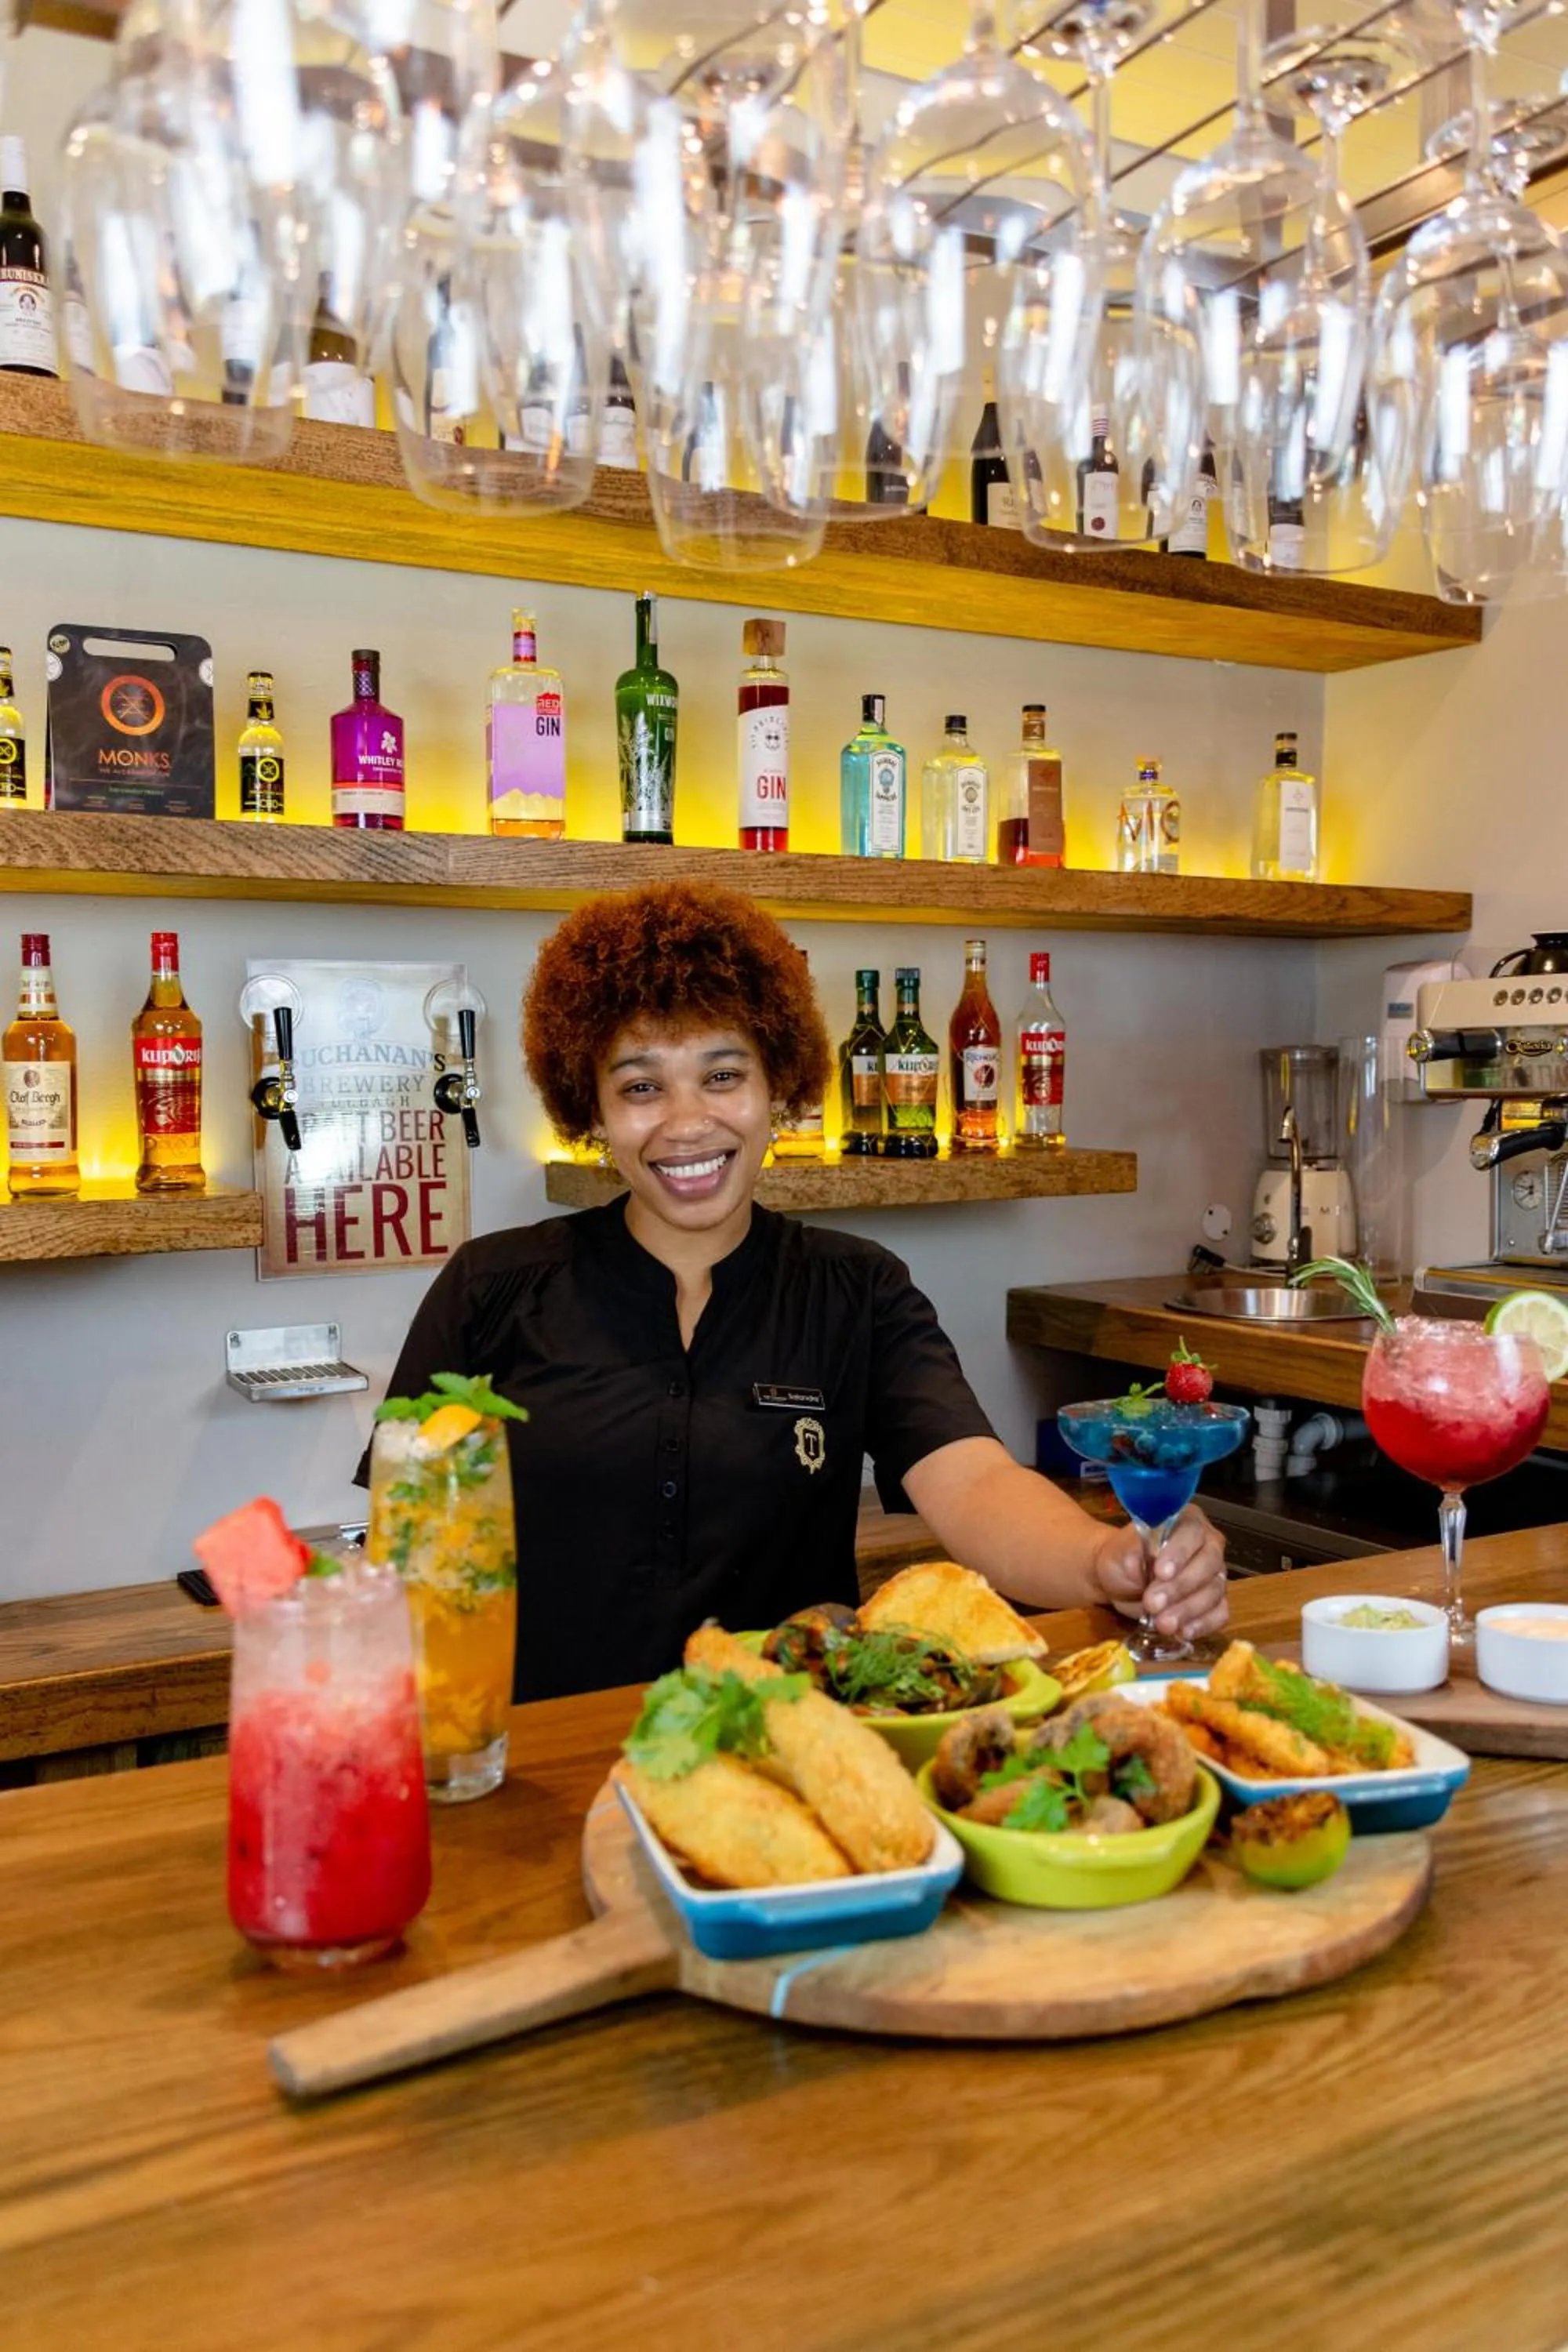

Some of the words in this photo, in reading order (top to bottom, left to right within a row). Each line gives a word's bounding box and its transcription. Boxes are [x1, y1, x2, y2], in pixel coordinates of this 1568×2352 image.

[535, 716, 561, 737] GIN
[99, 749, 170, 768] MONKS
[358, 755, 395, 766] WHITLEY
[757, 775, 786, 800] GIN
[293, 1044, 446, 1072] UCHANAN'S
[301, 1074, 425, 1094] BREWERY
[380, 1109, 445, 1142] BEER
[285, 1143, 447, 1184] AILABLE
[285, 1181, 448, 1264] HERE
